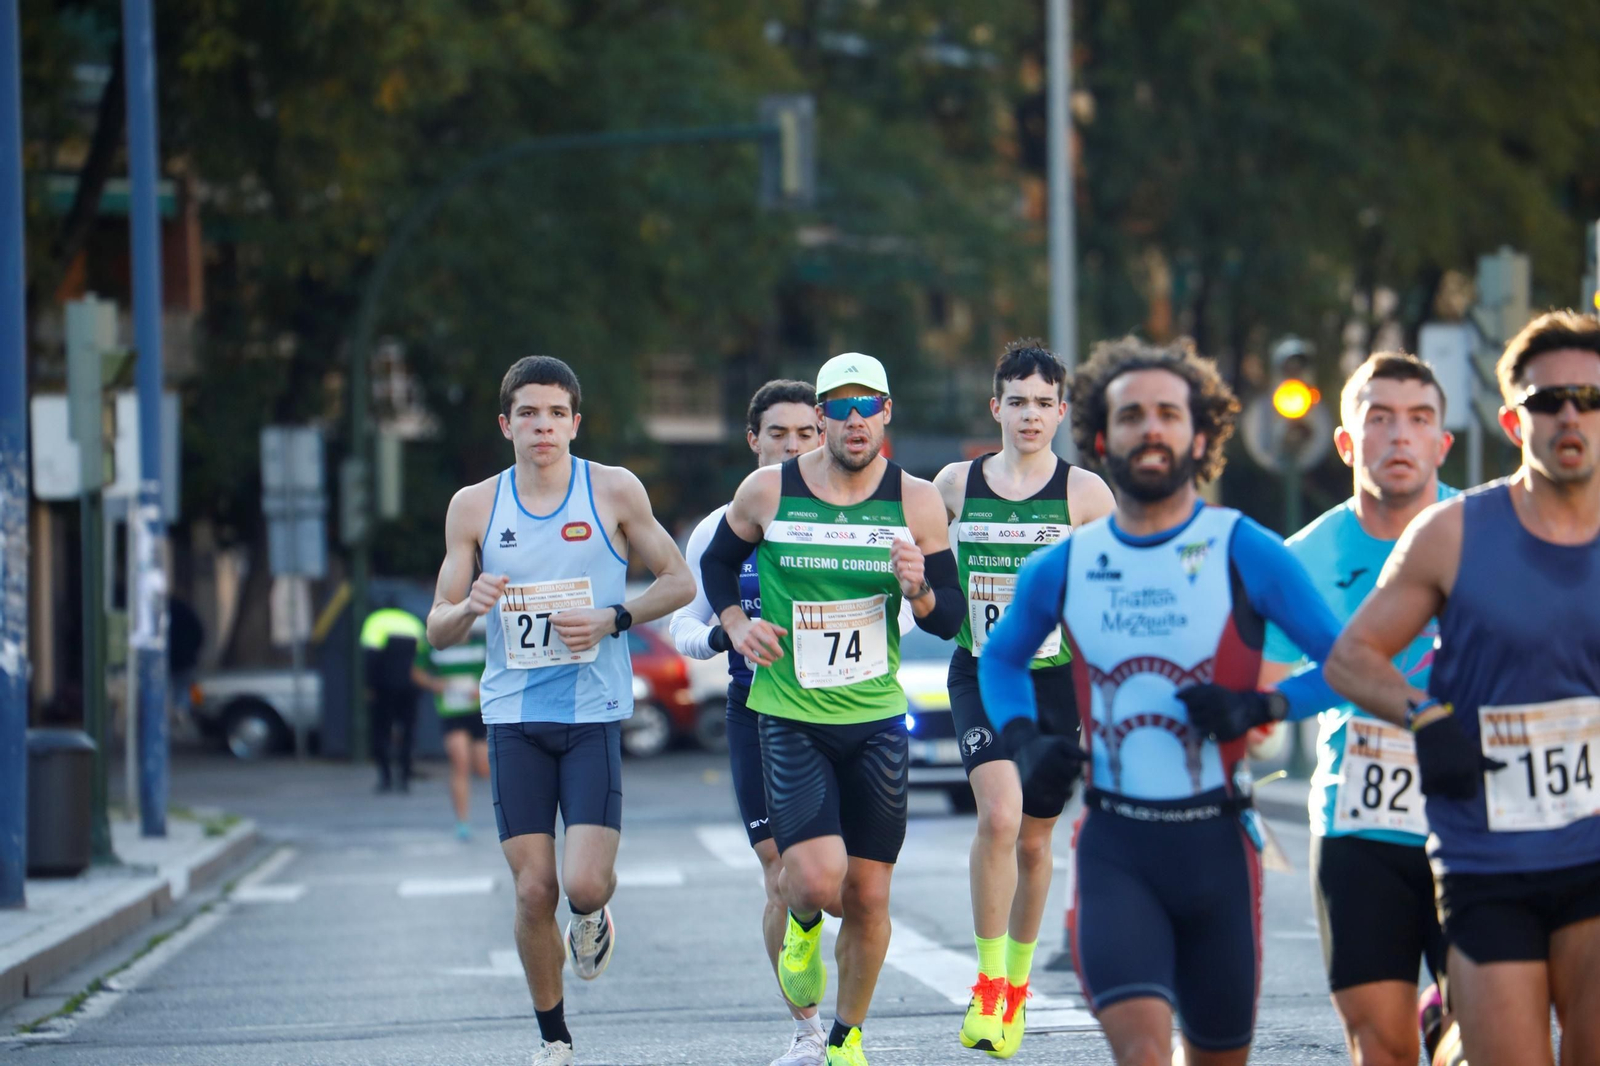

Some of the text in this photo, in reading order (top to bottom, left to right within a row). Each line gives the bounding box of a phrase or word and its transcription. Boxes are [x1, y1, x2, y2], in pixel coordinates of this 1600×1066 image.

[780, 556, 838, 570] ATLETISMO
[968, 555, 1011, 567] ATLETISMO
[503, 587, 526, 611] XLI
[972, 576, 994, 601] XLI
[518, 610, 563, 648] 27
[798, 606, 825, 630] XLI
[824, 630, 862, 666] 74
[1350, 722, 1381, 759] XLI
[1485, 713, 1530, 746] XLI
[1518, 742, 1593, 798] 154
[1362, 763, 1412, 812] 82
